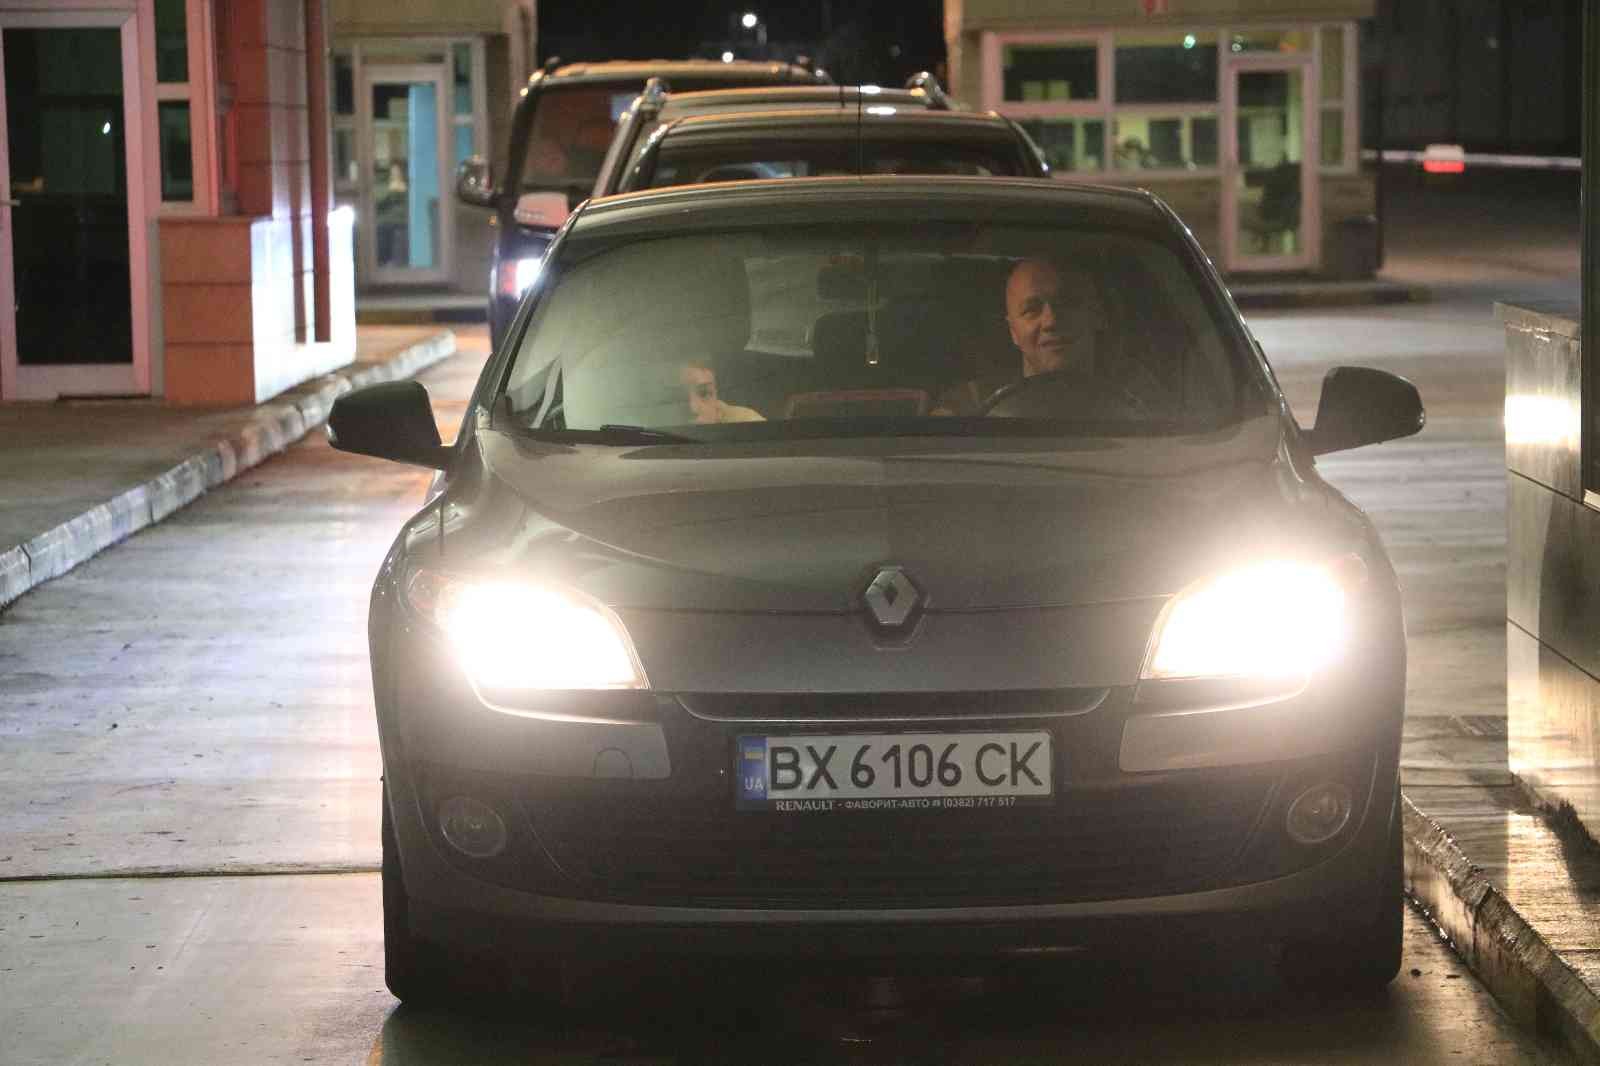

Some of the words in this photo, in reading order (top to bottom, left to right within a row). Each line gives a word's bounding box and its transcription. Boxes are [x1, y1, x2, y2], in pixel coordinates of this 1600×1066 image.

[769, 745, 839, 791] BX
[851, 743, 962, 789] 6106
[975, 741, 1043, 787] CK
[744, 777, 764, 791] UA
[775, 799, 833, 811] RENAULT
